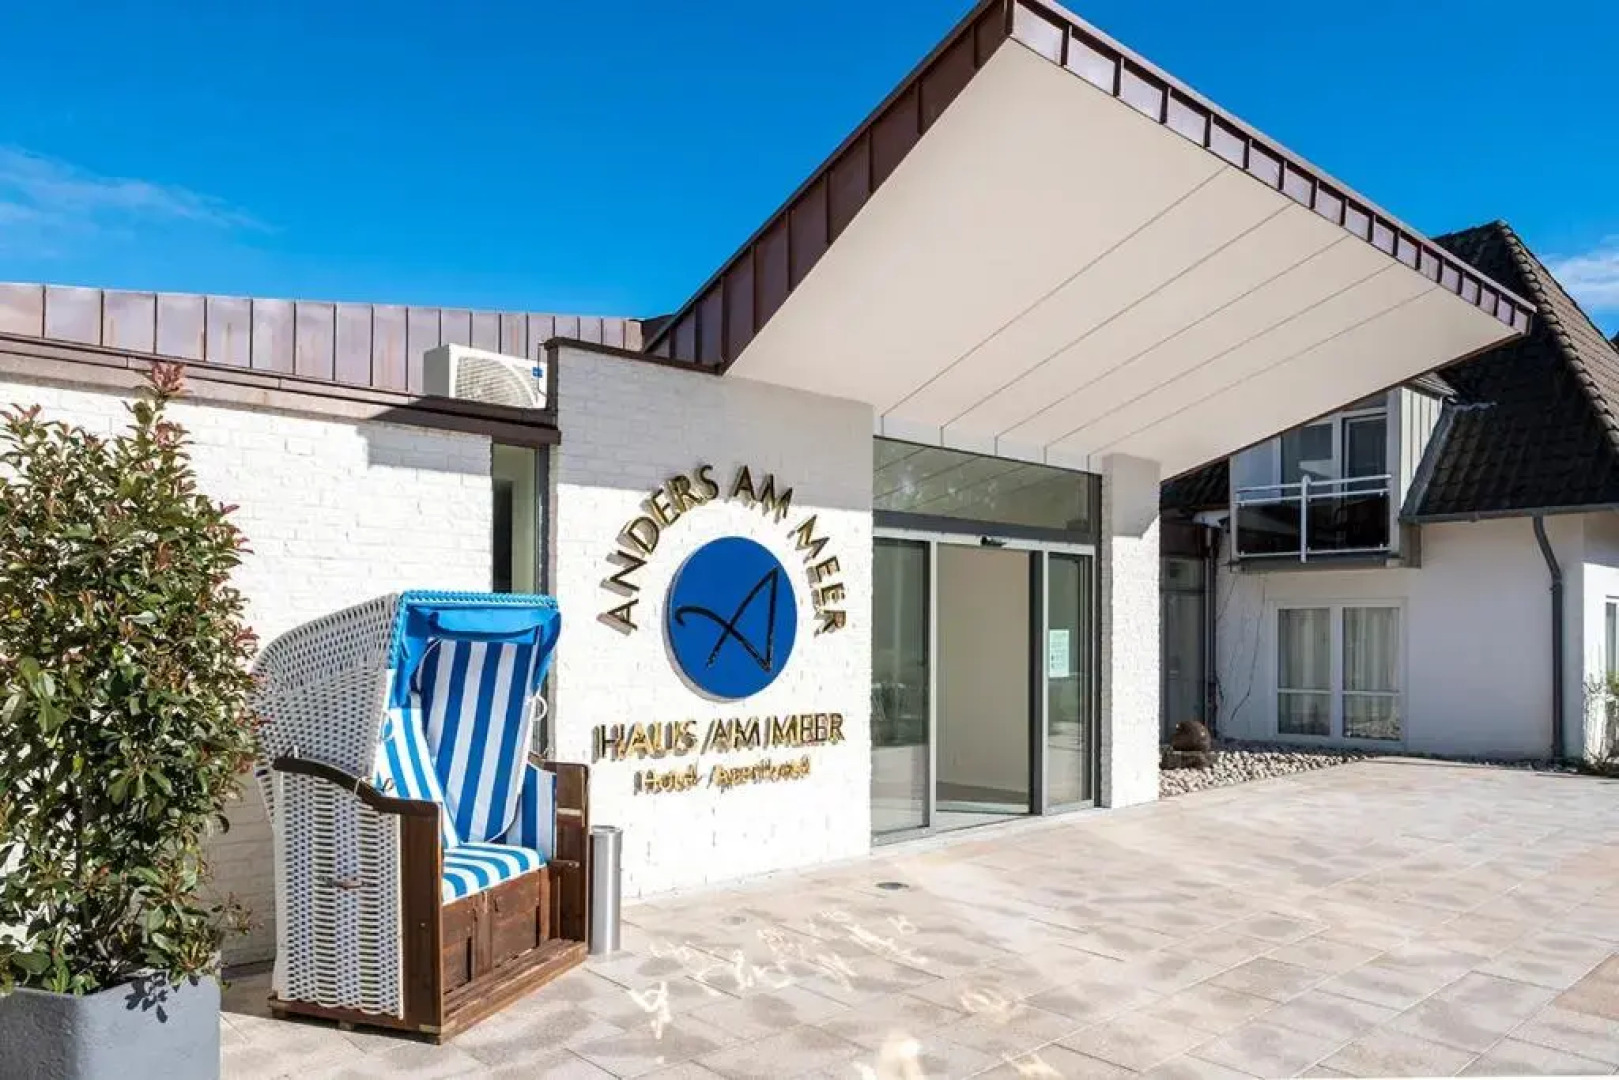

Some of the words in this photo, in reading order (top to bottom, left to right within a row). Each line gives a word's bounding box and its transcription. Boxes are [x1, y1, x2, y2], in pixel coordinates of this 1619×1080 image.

[598, 464, 720, 635] ANDERS
[726, 464, 794, 523] AM
[788, 514, 847, 637] MEER
[592, 719, 698, 763] HAUS
[702, 716, 761, 754] AM
[764, 712, 845, 749] MEER
